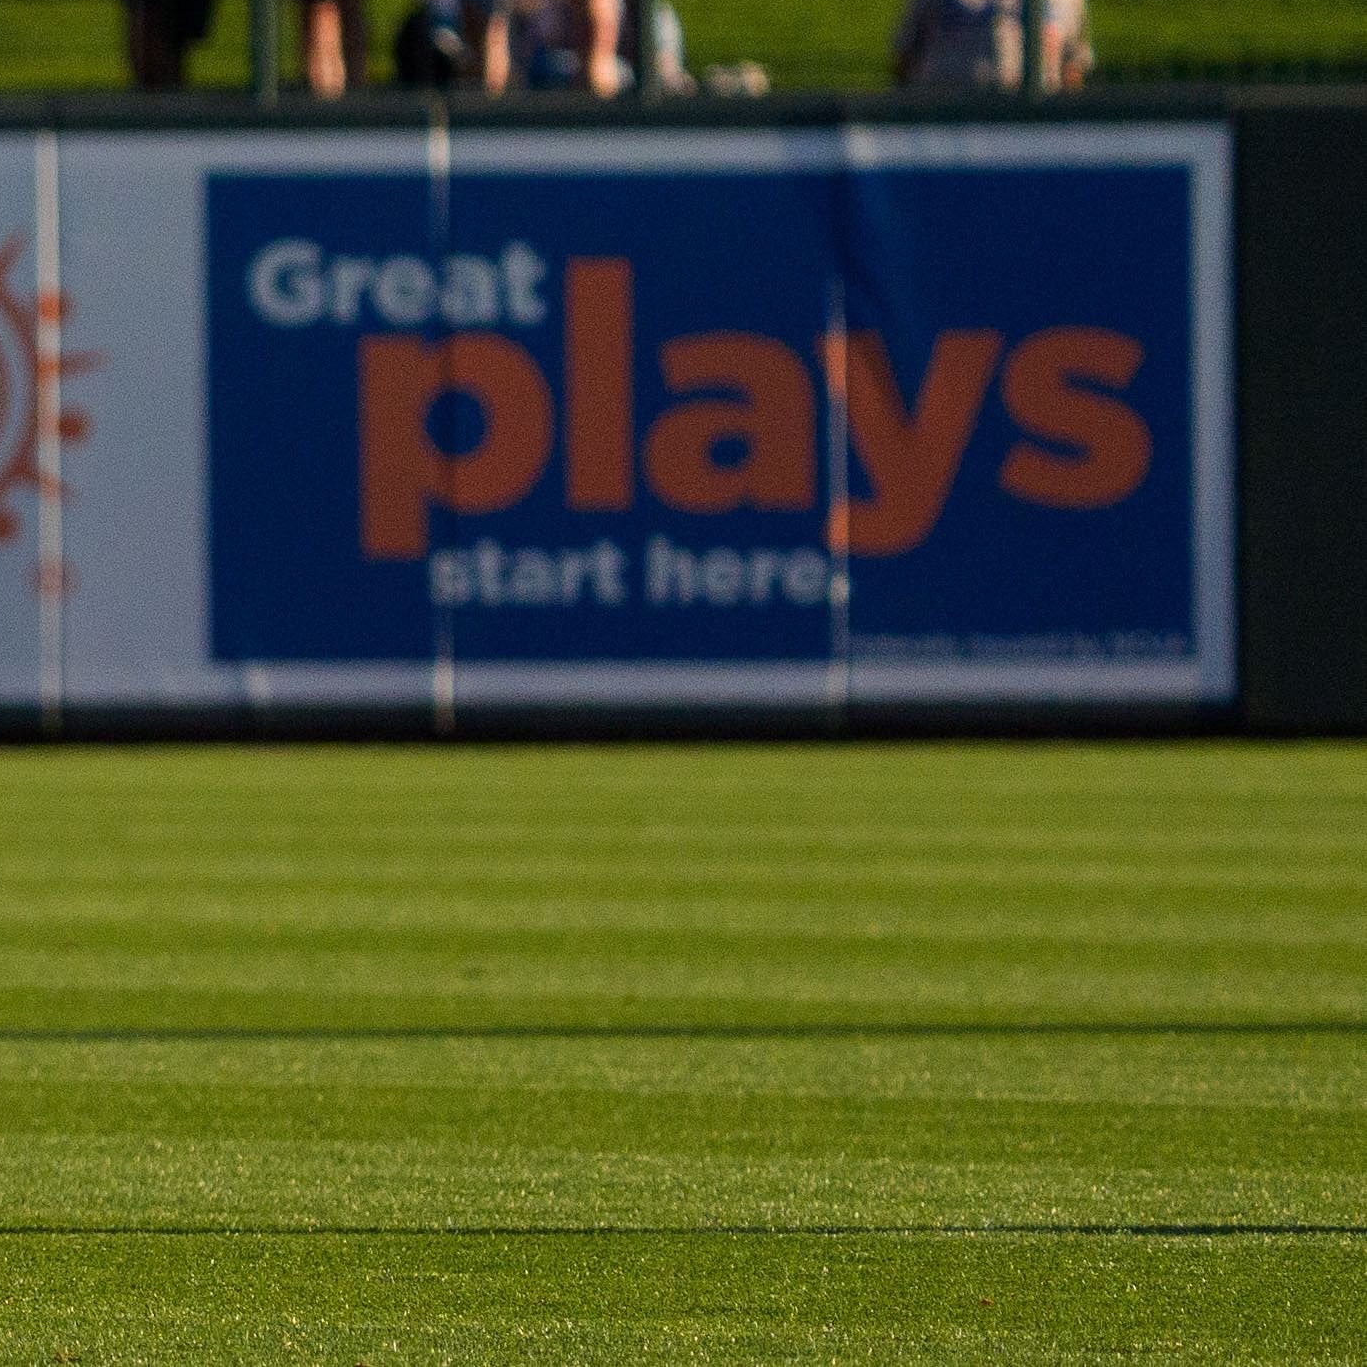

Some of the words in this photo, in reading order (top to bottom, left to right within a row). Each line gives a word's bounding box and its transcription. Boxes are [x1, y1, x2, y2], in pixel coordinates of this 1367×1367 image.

[249, 238, 547, 326] Great
[359, 255, 1154, 558] plays
[429, 539, 627, 607] start
